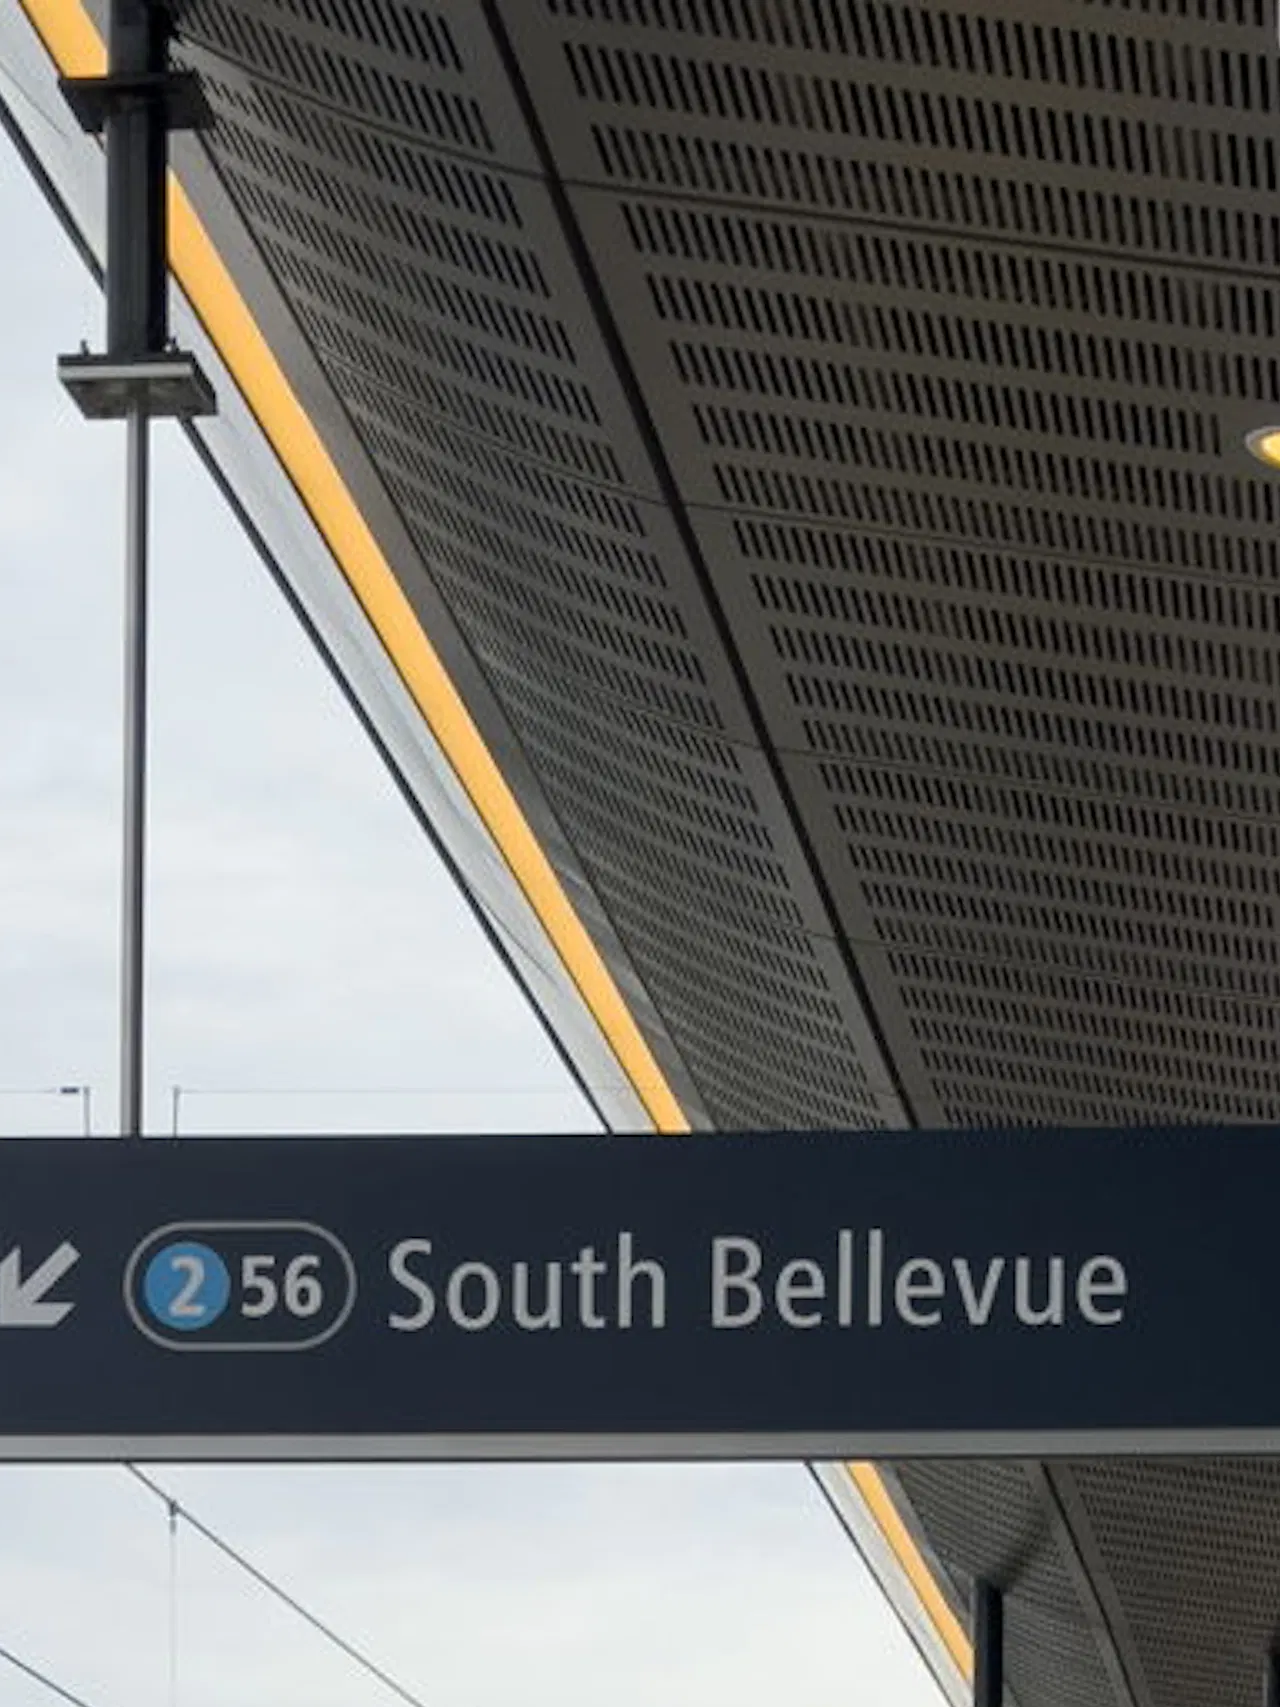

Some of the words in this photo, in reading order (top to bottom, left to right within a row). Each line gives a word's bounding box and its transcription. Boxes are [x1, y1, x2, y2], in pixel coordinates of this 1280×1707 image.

[169, 1255, 205, 1317] 2
[240, 1255, 323, 1318] 56
[388, 1231, 667, 1331] South
[711, 1229, 1126, 1328] Bellevue
